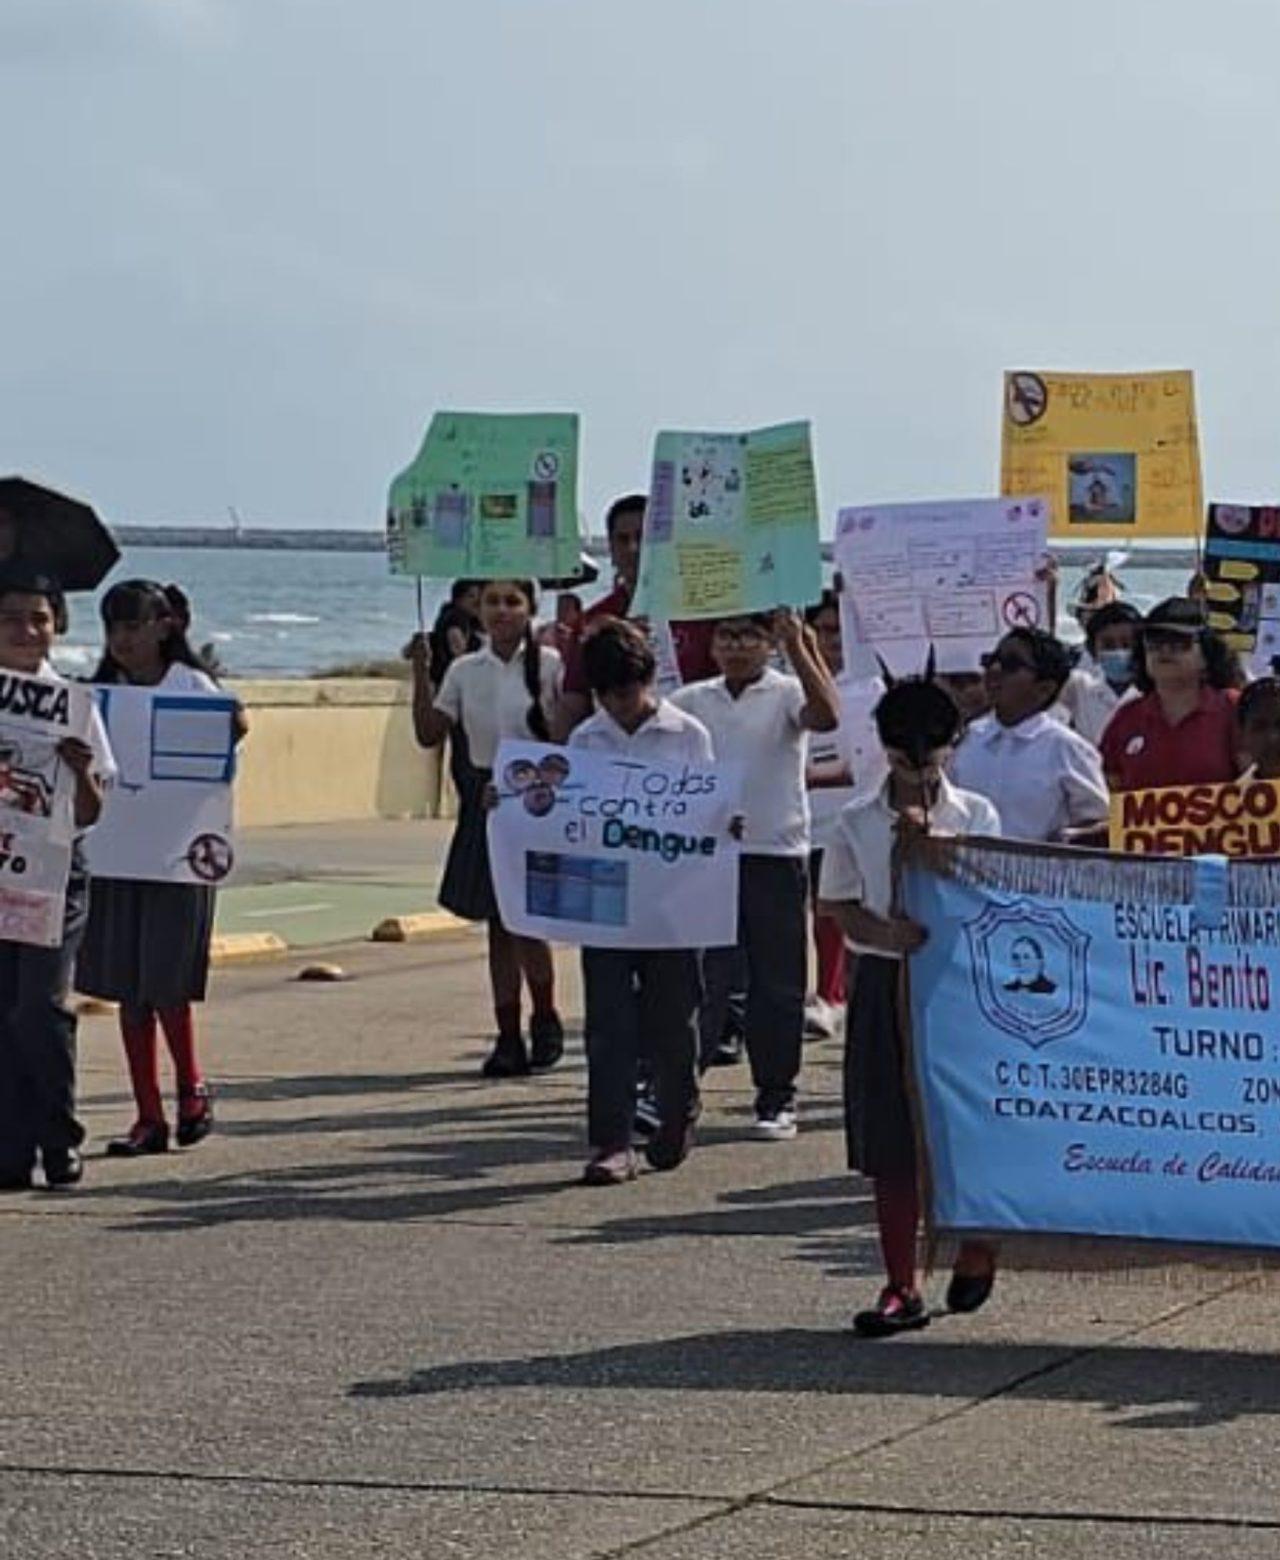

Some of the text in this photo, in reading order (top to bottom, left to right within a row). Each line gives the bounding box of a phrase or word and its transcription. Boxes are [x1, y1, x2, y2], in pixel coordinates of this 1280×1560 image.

[580, 797, 687, 818] contra
[1123, 782, 1278, 829] MOSCO
[602, 819, 717, 863] Dengue
[1115, 904, 1200, 943] ESCUELA
[1187, 946, 1271, 1012] Benito
[1063, 1143, 1152, 1175] Escuela
[1162, 1151, 1188, 1176] de
